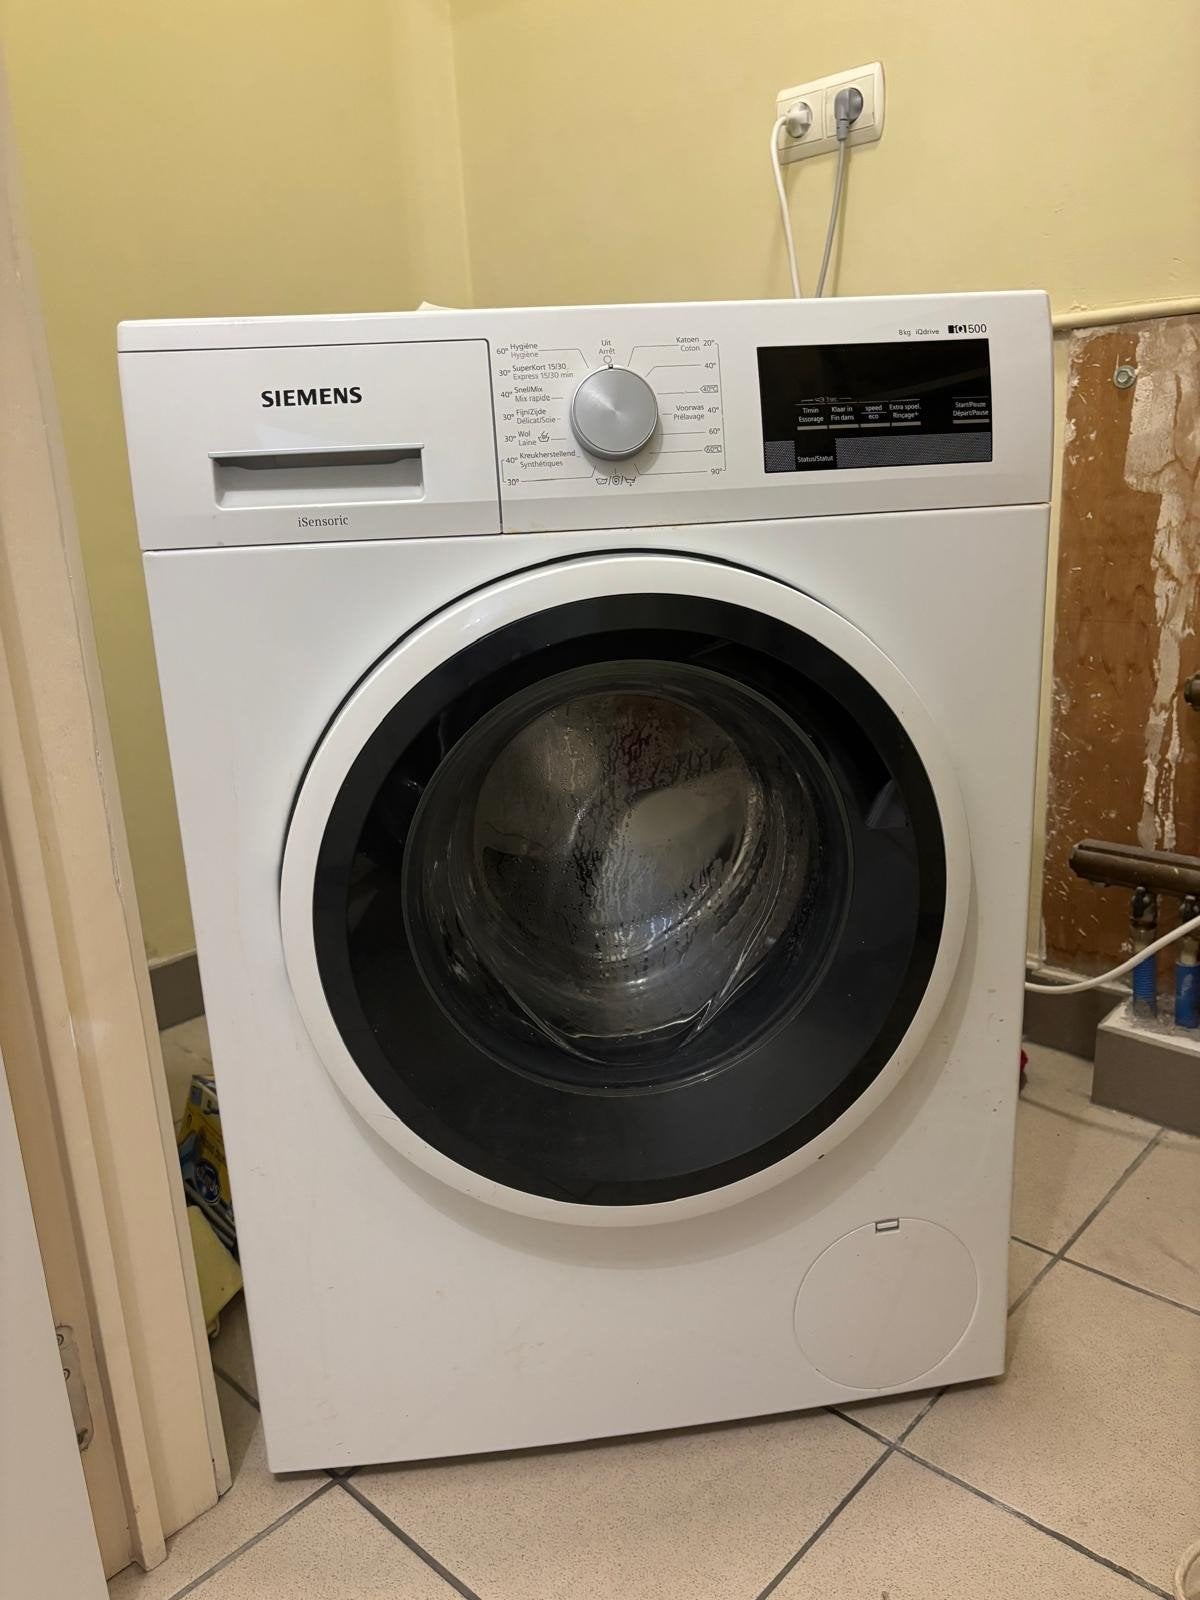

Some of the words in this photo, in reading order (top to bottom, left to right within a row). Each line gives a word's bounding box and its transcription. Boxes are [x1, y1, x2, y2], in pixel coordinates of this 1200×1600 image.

[496, 347, 509, 355] 60°
[598, 347, 616, 355] Arrêt
[512, 364, 546, 373] SuperKort
[498, 369, 511, 377] 30°
[513, 373, 539, 381] Express
[514, 386, 543, 394] Snell/Mix
[261, 386, 363, 408] SIEMENS
[529, 394, 551, 403] rapide
[864, 404, 883, 412] speed
[516, 408, 547, 417] Fijn/Zijde
[503, 413, 515, 421] 30°
[516, 416, 556, 424] Délicat/Soie
[673, 413, 704, 421] Prélavage
[798, 416, 824, 424] Essorage
[517, 430, 531, 438] Wol
[504, 435, 517, 443] 30°
[519, 449, 576, 459] Kreukherstellend
[520, 459, 564, 469] Synthétiques
[710, 468, 722, 476] 90°
[507, 478, 520, 486] 30°
[297, 514, 349, 529] iSensoric
